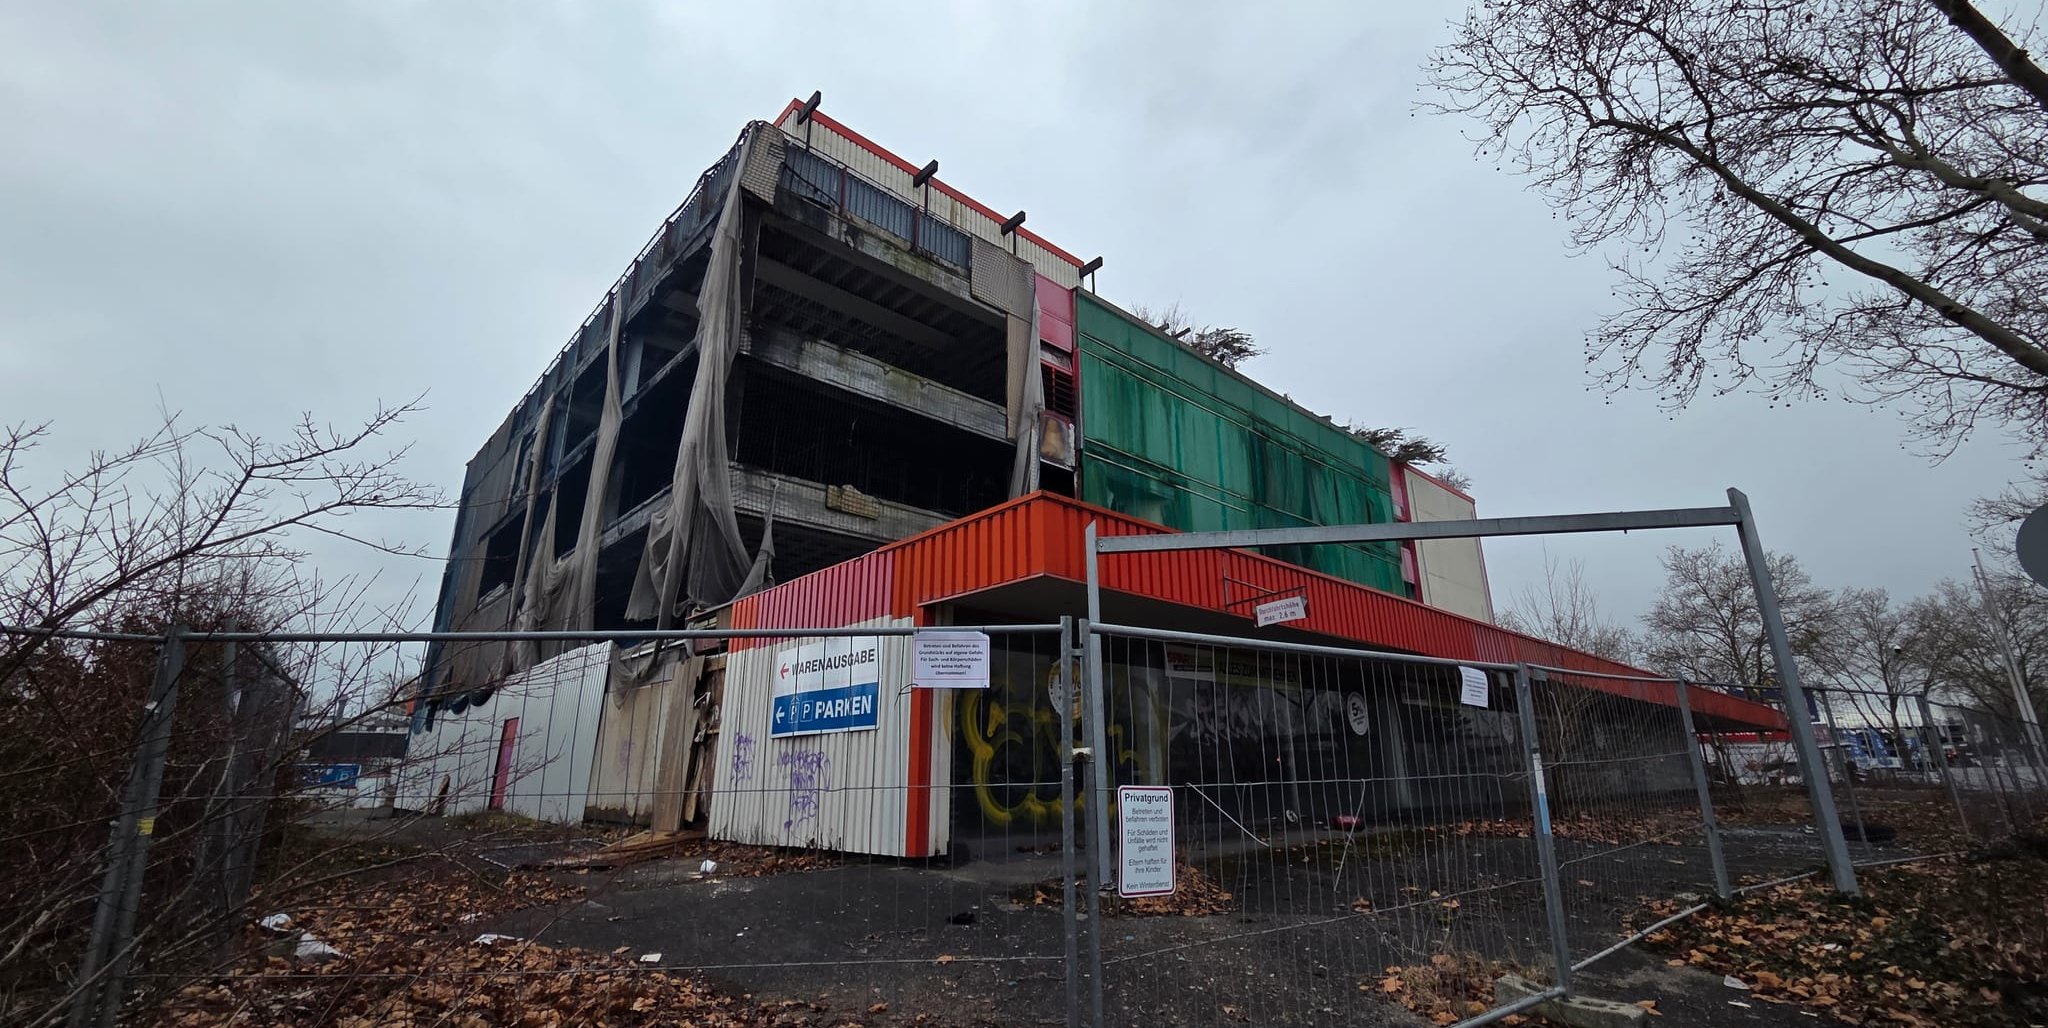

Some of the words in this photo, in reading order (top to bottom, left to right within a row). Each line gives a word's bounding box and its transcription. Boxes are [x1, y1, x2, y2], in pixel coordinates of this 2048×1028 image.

[792, 648, 875, 676] WARENAUSGABE
[815, 695, 872, 719] PARKEN
[1124, 793, 1168, 804] Privatgrund
